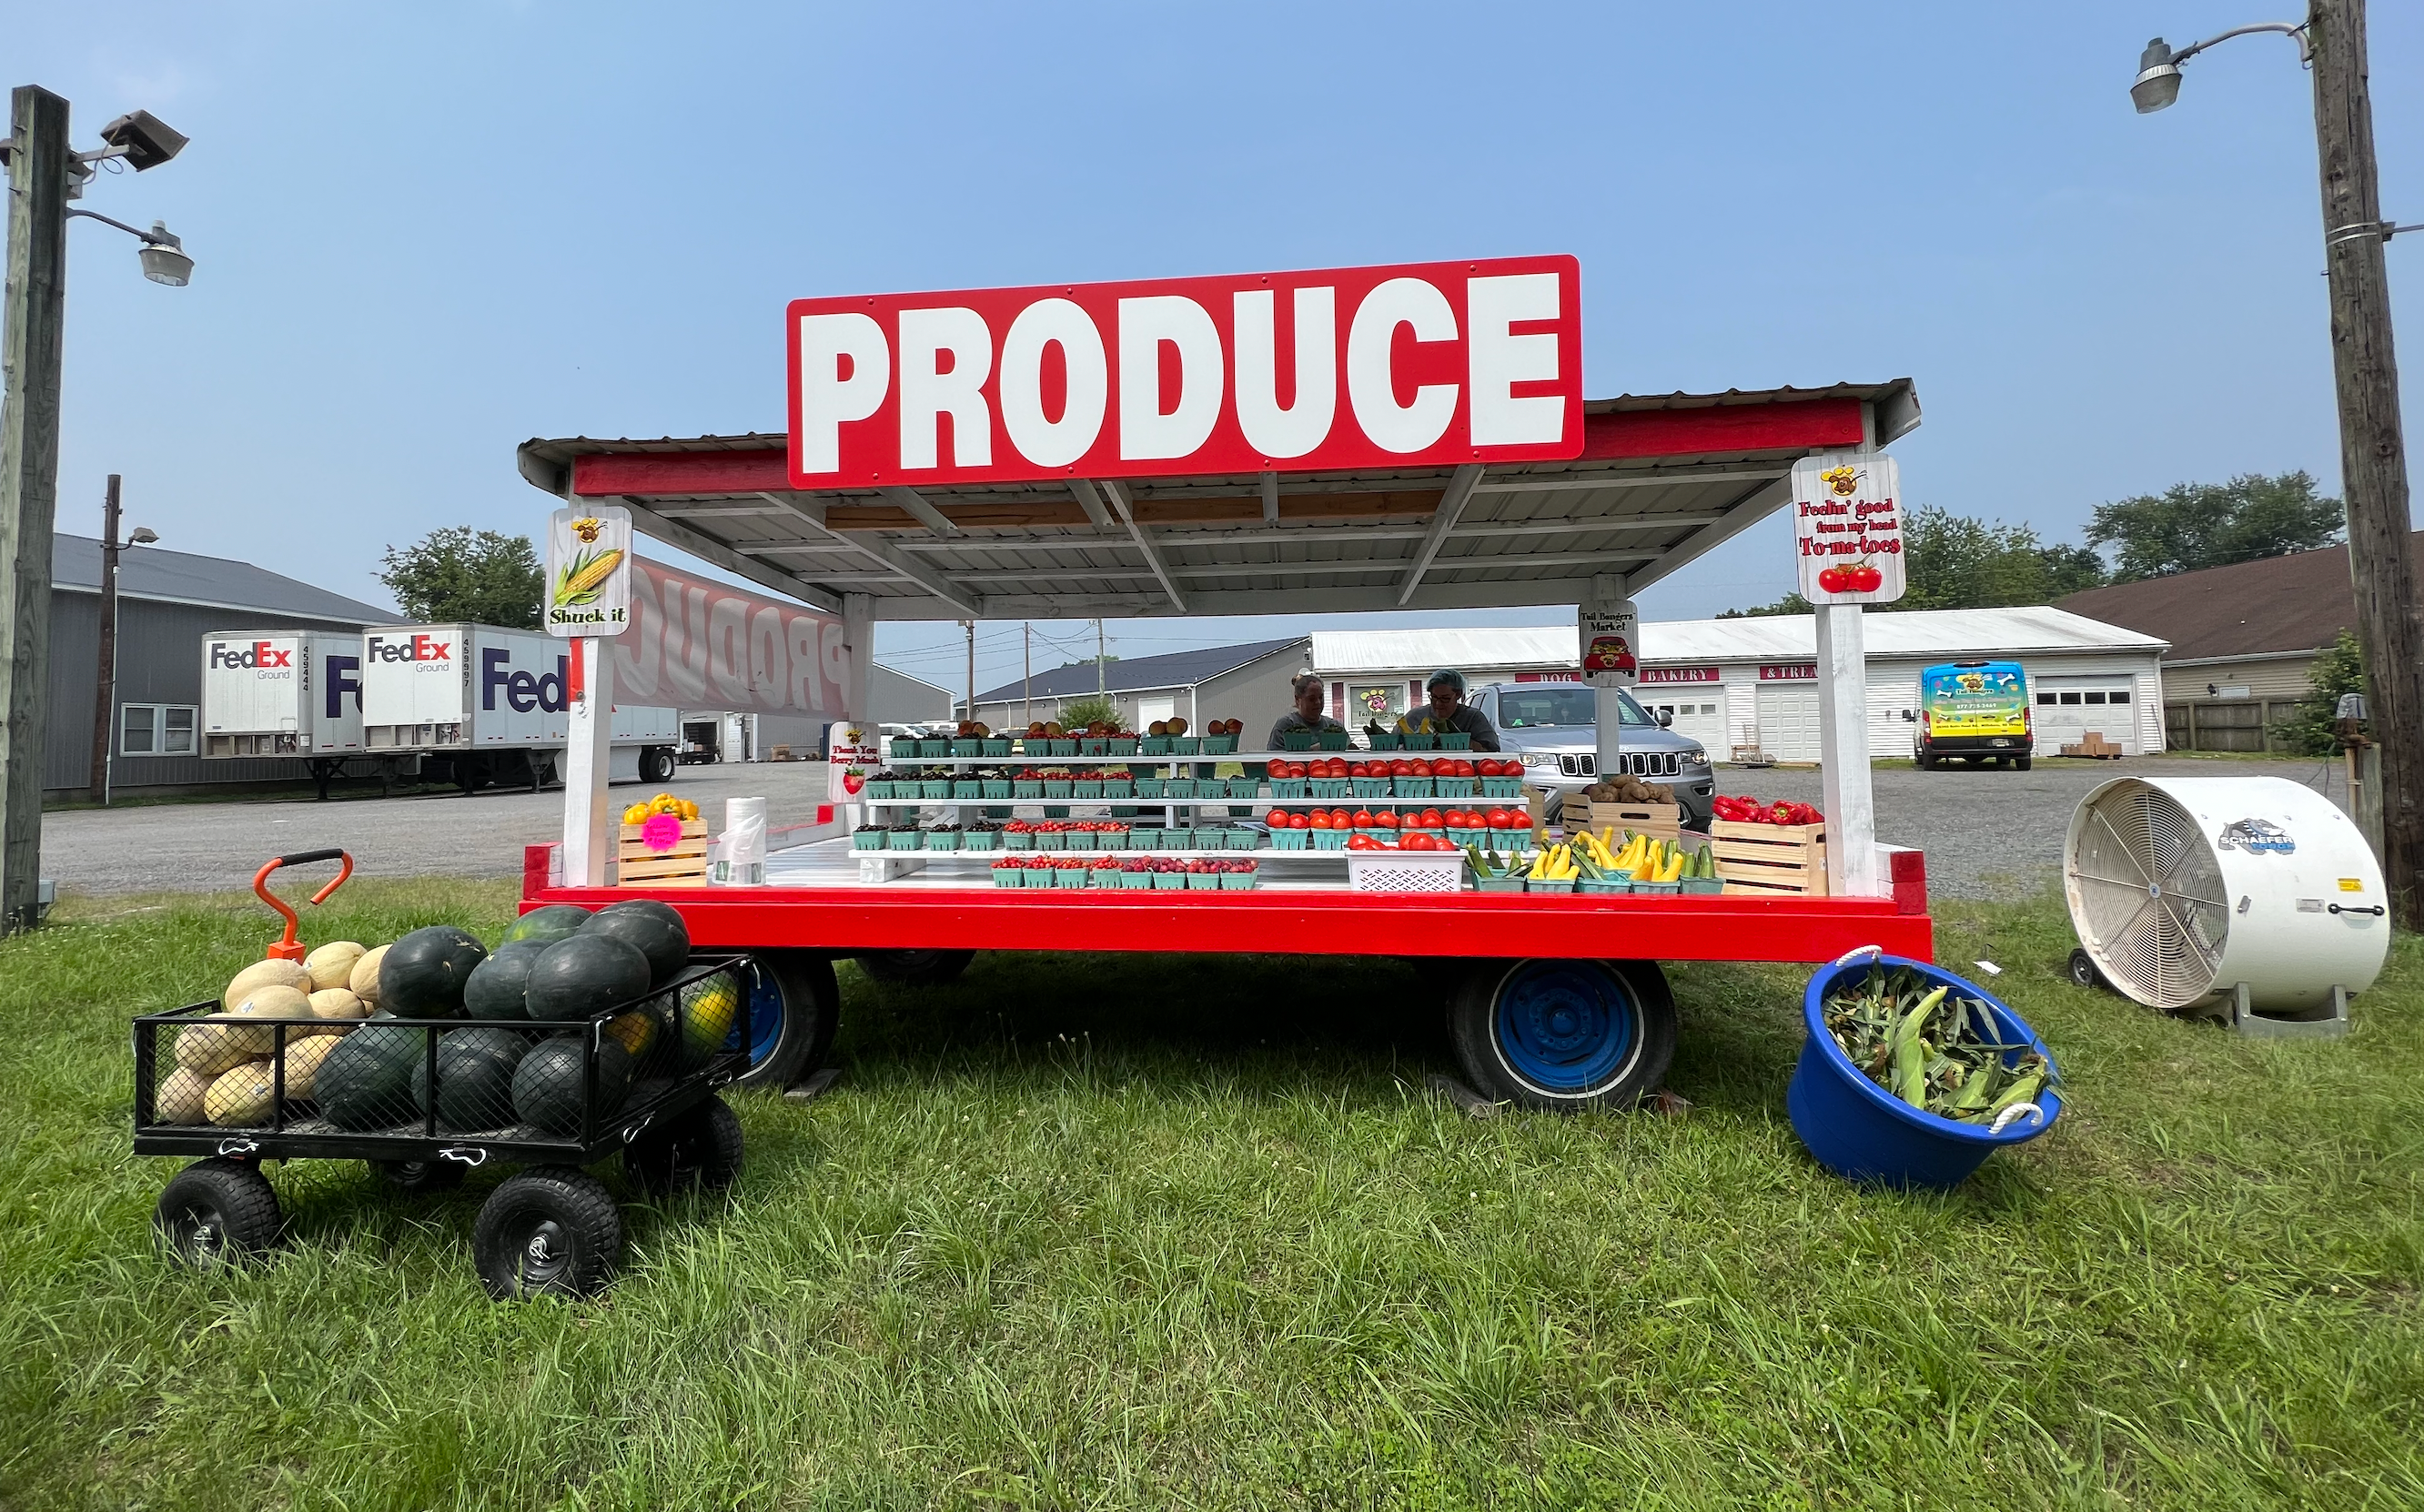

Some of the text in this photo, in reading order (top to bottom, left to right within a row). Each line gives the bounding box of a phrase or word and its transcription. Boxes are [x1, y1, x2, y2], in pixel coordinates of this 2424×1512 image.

[801, 273, 1565, 475] PRODUCE
[1798, 499, 1894, 520] Feelin' good
[1816, 519, 1898, 534] from my head
[550, 608, 627, 624] Shuck it
[1590, 621, 1627, 632] Market
[211, 641, 292, 670] FedEx
[369, 634, 451, 662] FedEx
[258, 670, 290, 680] Ground
[415, 662, 449, 673] Ground
[1540, 665, 1819, 682] DOG BAKERY & TREA
[482, 647, 571, 713] Fed
[833, 745, 878, 754] Thank You
[2219, 836, 2294, 844] SCHAEFER
